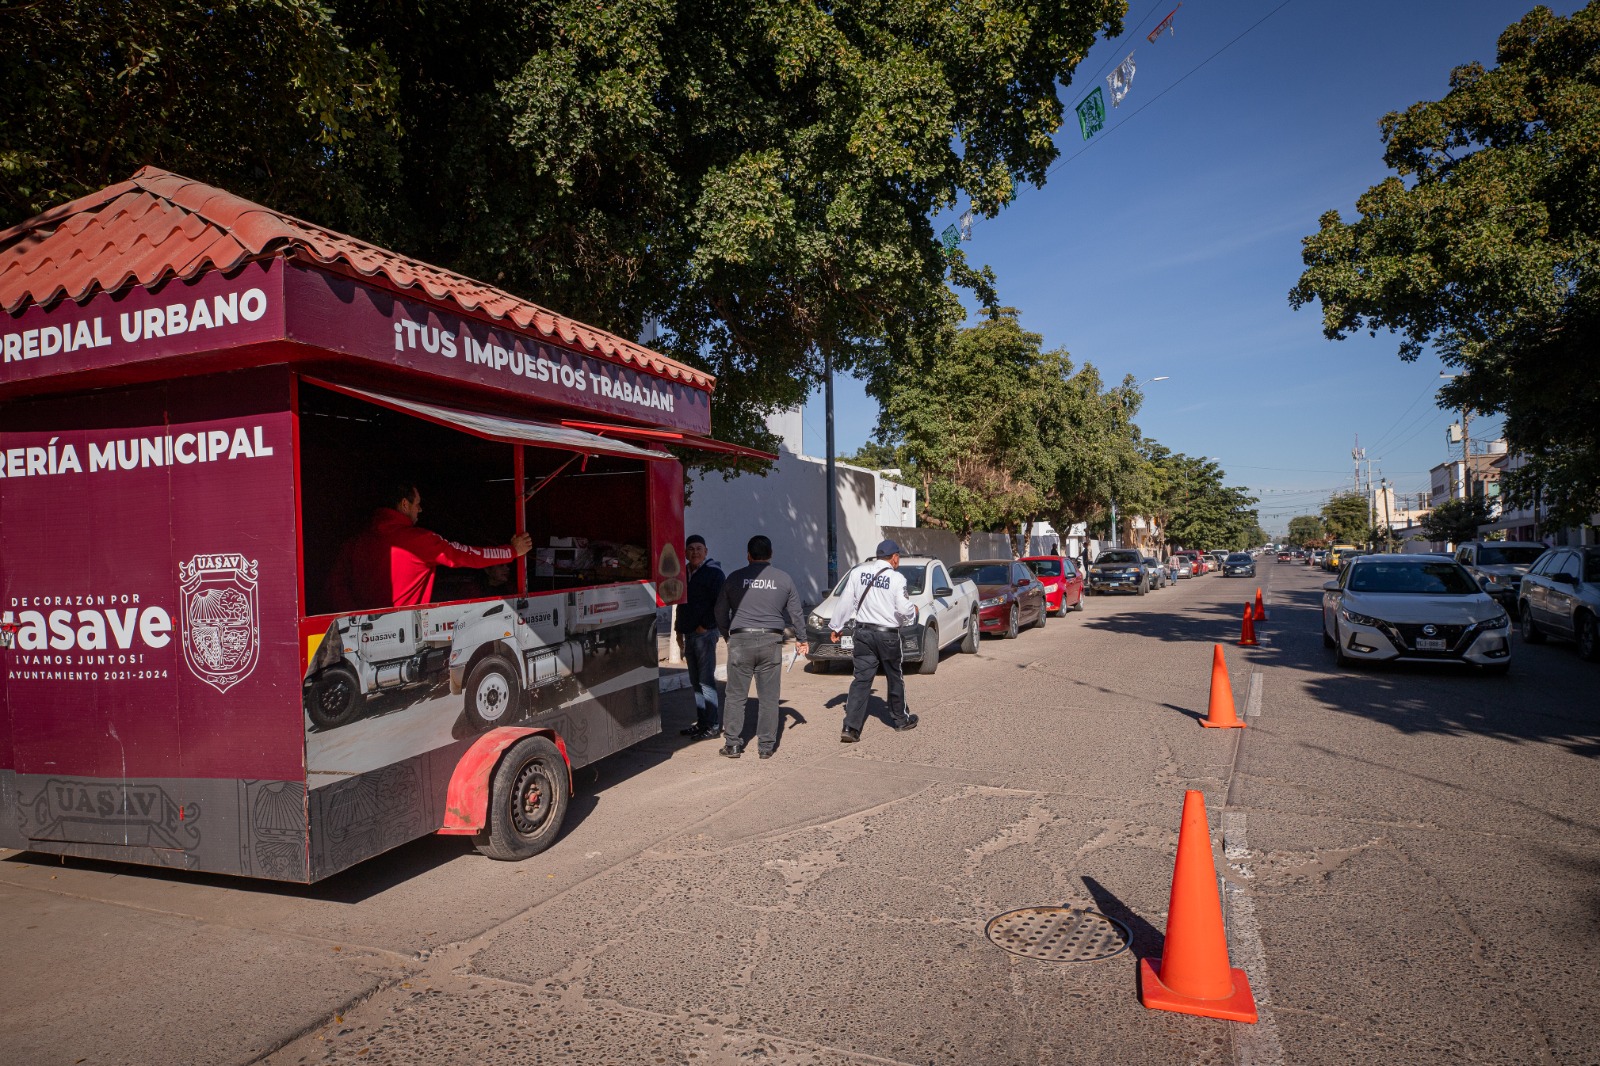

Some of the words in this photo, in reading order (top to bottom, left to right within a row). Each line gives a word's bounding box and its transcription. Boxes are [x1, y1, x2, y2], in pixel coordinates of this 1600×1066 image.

[0, 317, 111, 363] REDIAL
[120, 288, 267, 343] URBANO
[393, 318, 458, 358] ¡TUS
[463, 336, 587, 391] IMPUESTOS
[589, 373, 674, 413] TRABAJAN!
[88, 426, 274, 473] MUNICIPAL
[742, 578, 777, 590] PREDIAL
[11, 597, 28, 607] DE
[34, 594, 104, 607] CORAZÓN
[111, 594, 140, 604] POR
[517, 612, 551, 625] Guasave
[361, 632, 397, 643] Guasave
[16, 654, 72, 665] ¡VAMOS
[77, 654, 144, 665] JUNTOS!
[8, 670, 98, 681] AYUNTAMIENTO
[104, 669, 168, 680] 2021-2024
